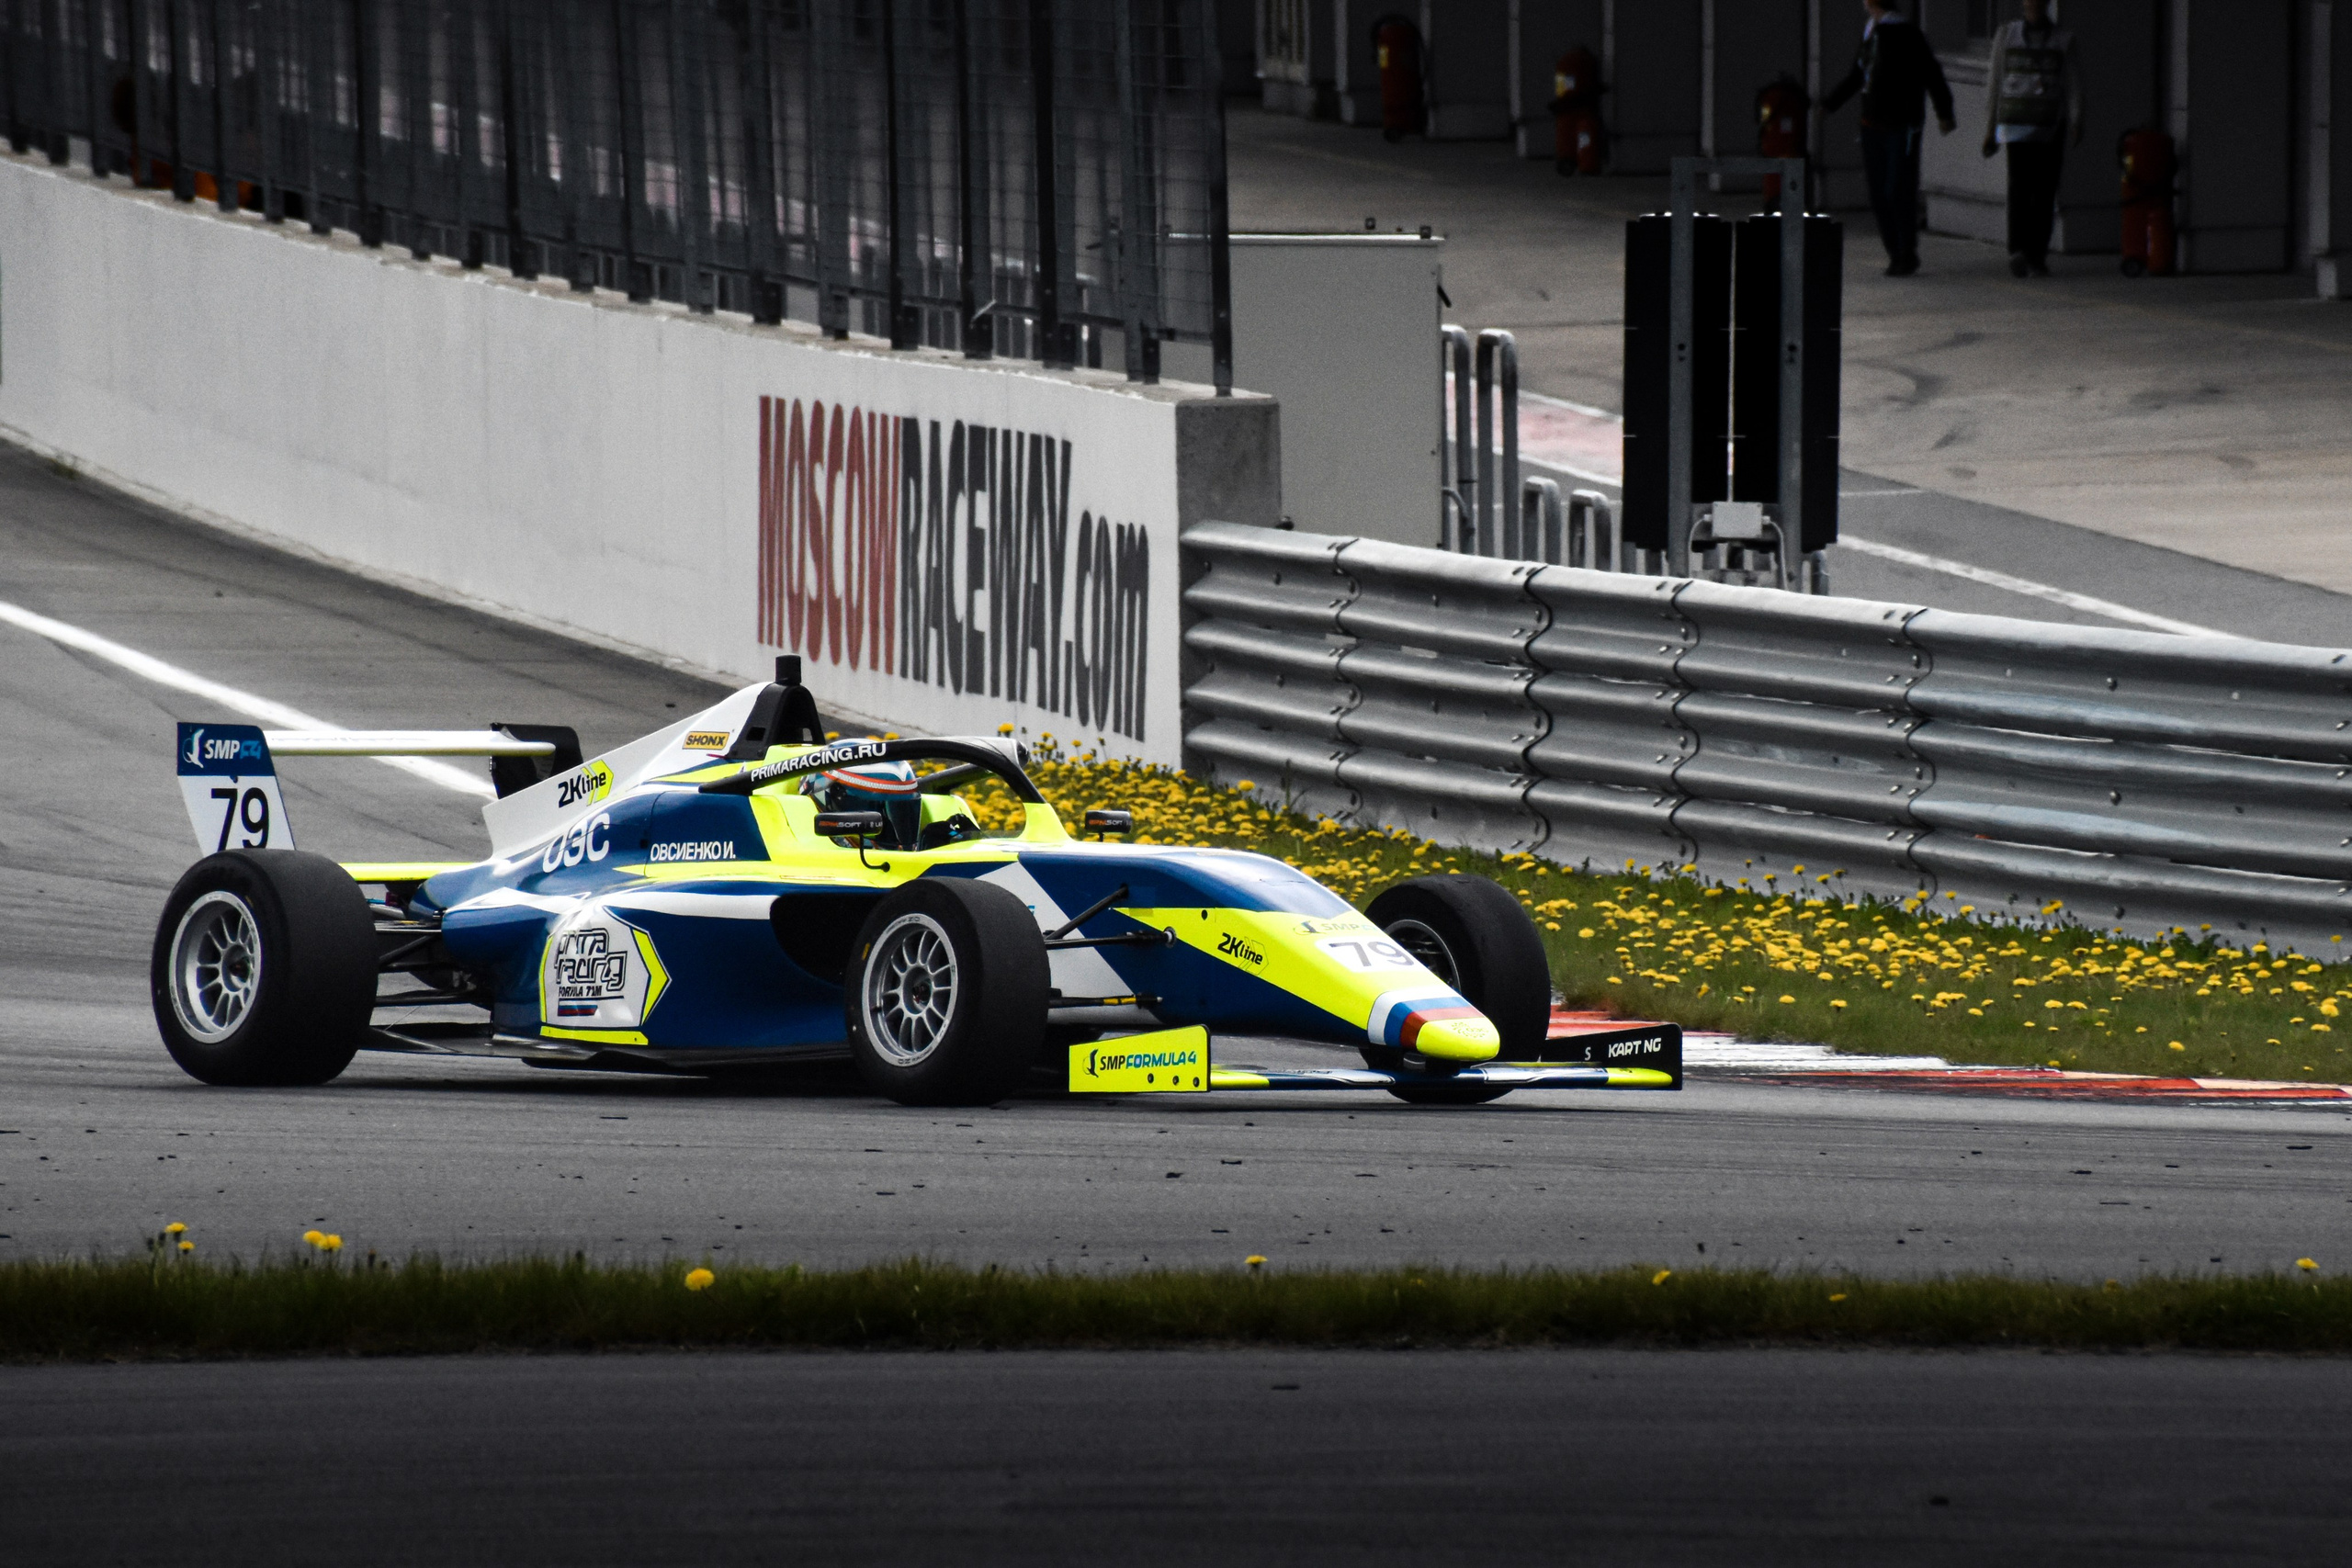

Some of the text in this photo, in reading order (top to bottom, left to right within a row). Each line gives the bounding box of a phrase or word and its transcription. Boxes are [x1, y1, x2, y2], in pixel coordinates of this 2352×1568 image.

[685, 735, 725, 747] SHONX
[751, 743, 887, 782] PRIMARACING.RU
[210, 787, 269, 852] 79
[650, 840, 721, 862] ОВСИЕНКО
[1329, 941, 1415, 967] 79
